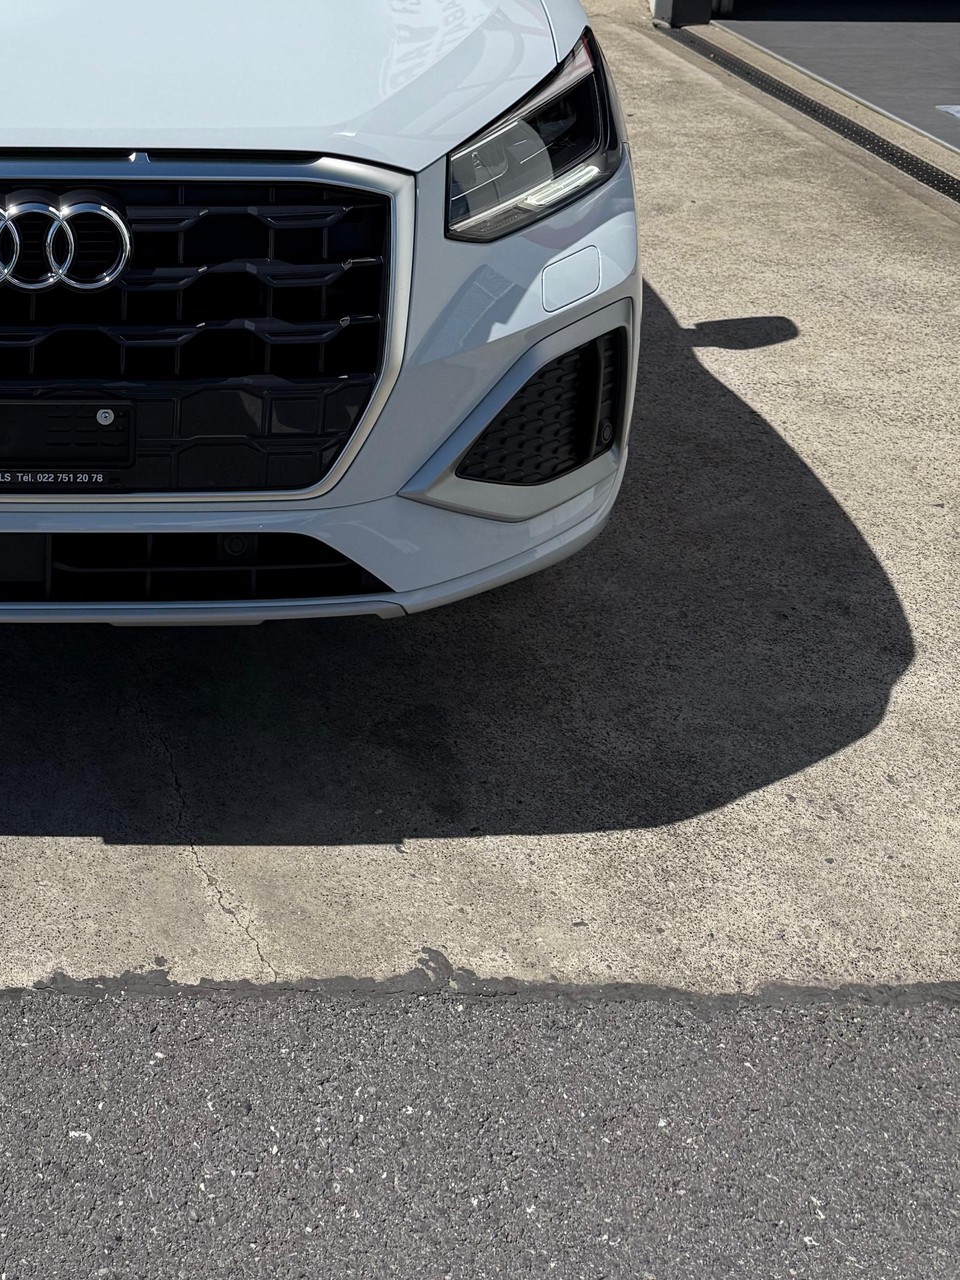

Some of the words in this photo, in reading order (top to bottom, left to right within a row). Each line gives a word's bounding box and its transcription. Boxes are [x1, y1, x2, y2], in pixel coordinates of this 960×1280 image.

[16, 472, 35, 482] Tél.
[36, 472, 54, 483] 022
[57, 473, 75, 483] 751
[76, 473, 89, 483] 20
[90, 473, 103, 483] 78
